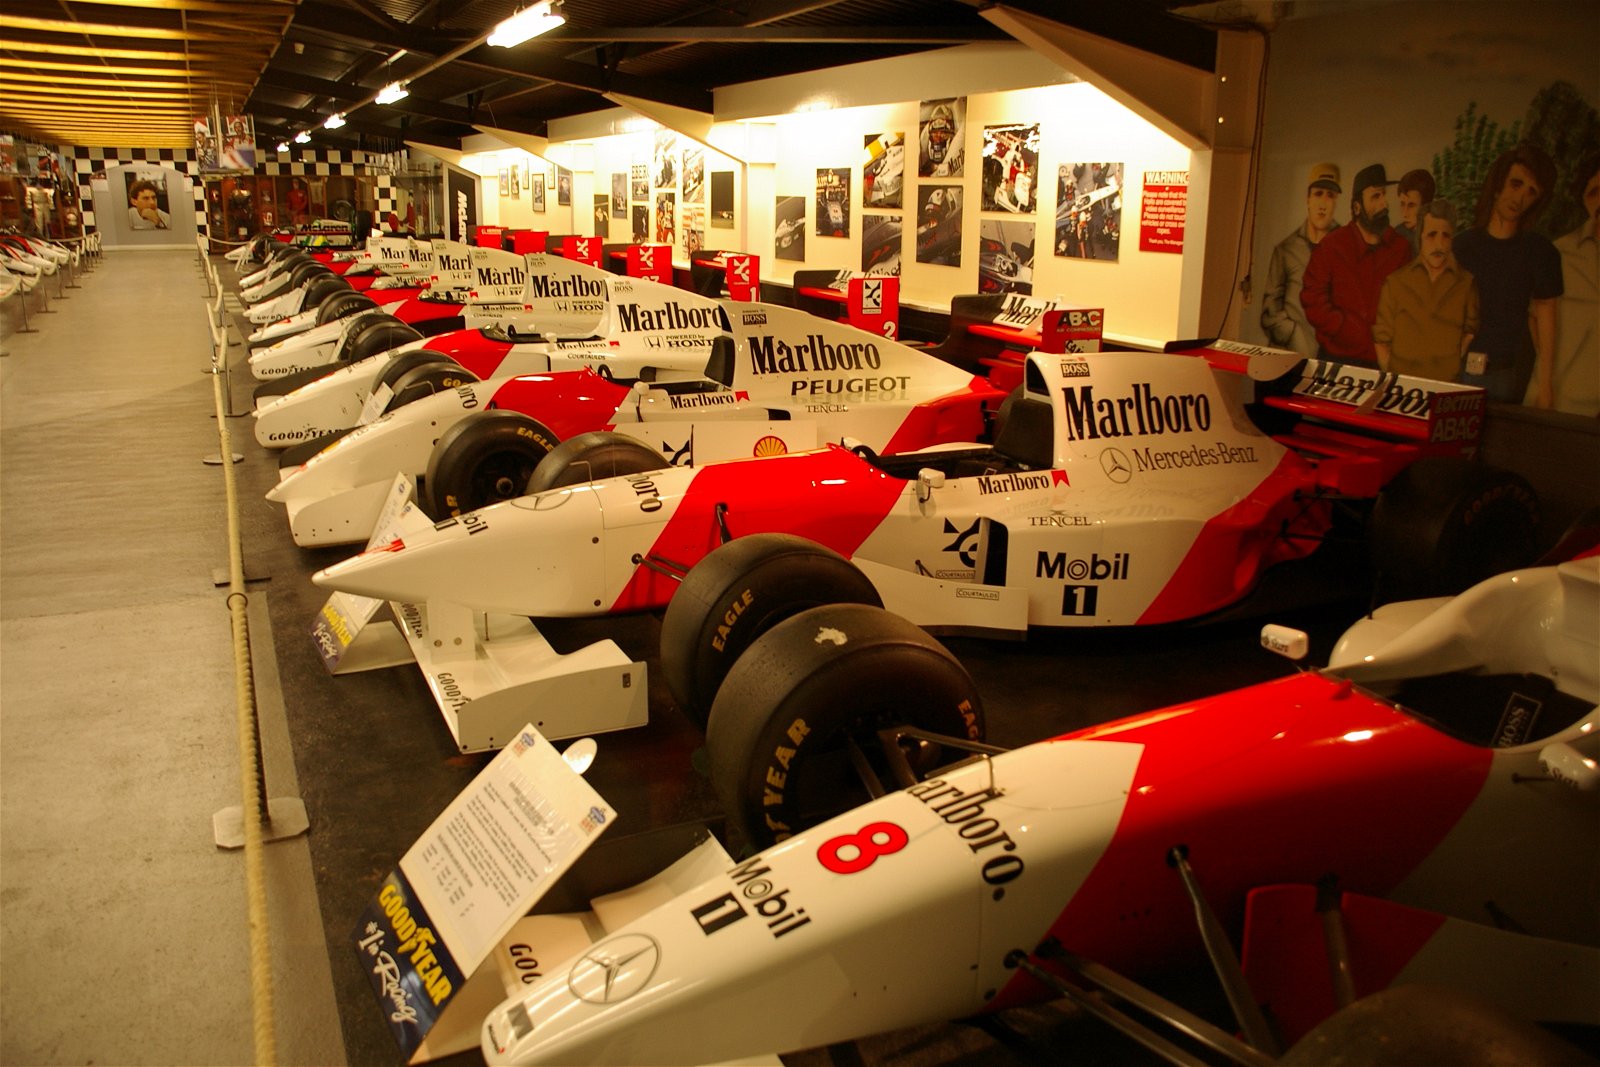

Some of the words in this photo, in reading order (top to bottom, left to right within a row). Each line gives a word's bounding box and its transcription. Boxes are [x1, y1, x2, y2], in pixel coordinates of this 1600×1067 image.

[883, 320, 897, 341] 2
[557, 341, 607, 351] Marlboro
[747, 334, 881, 375] Marlboro
[1062, 363, 1089, 374] BOSS
[791, 376, 911, 397] PEUGEOT
[670, 392, 735, 410] Marlboro
[805, 404, 849, 414] TENCEL
[1061, 383, 1211, 441] Marlboro
[516, 427, 554, 453] EAGLE
[1431, 415, 1481, 443] ABAC
[1132, 442, 1258, 472] Mercedes-Benz
[976, 474, 1050, 496] Marlboro
[1028, 515, 1092, 528] TENCEL
[1035, 550, 1130, 581] Mobil
[957, 589, 998, 600] COURTAULDS
[711, 588, 755, 653] EAGLE
[1498, 705, 1526, 747] BOSS
[816, 821, 909, 875] 8
[725, 858, 812, 940] Mobil
[379, 883, 453, 1007] GOODYEAR
[358, 921, 385, 951] #1
[373, 950, 419, 1024] Racing
